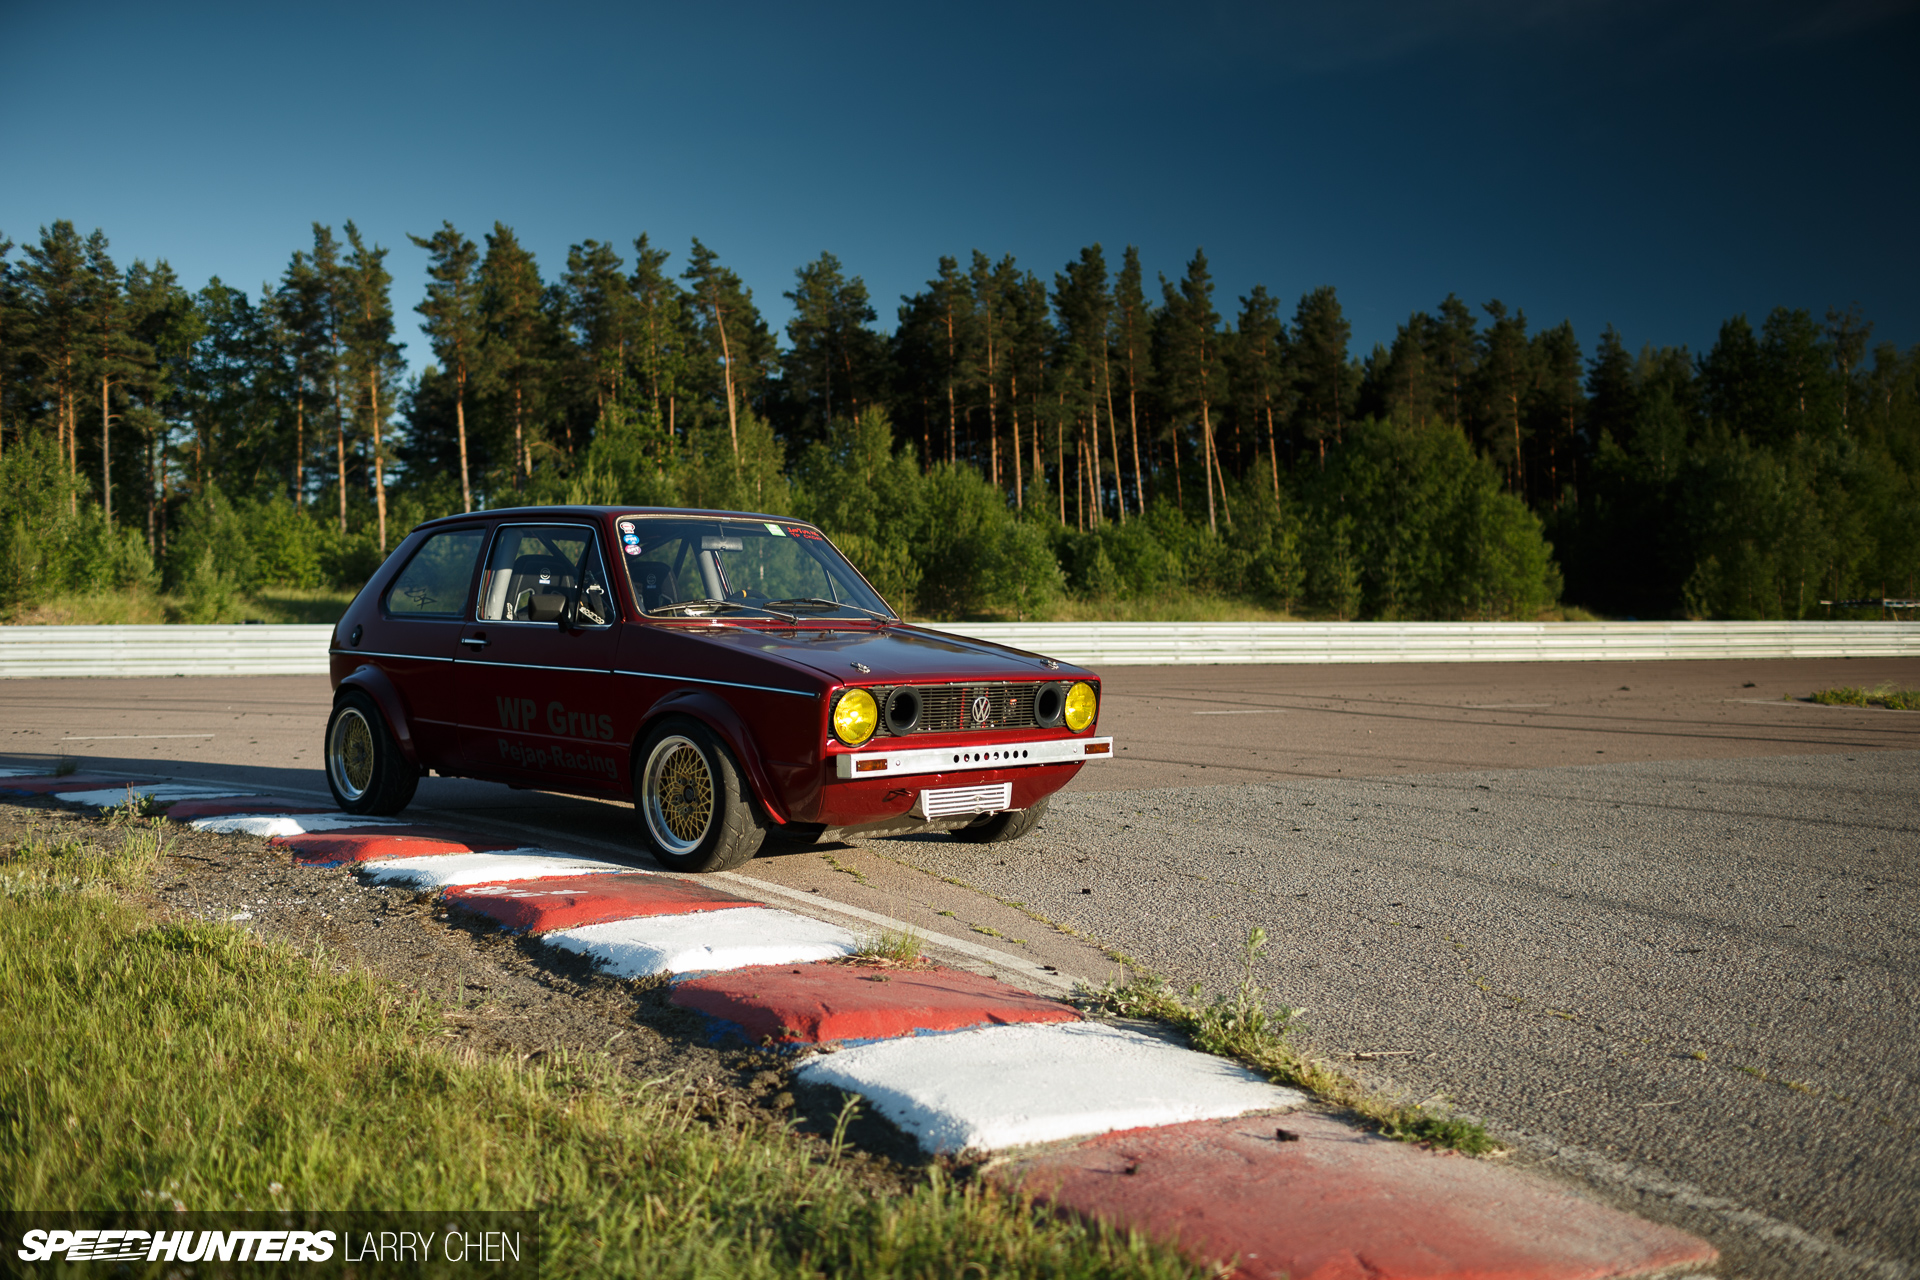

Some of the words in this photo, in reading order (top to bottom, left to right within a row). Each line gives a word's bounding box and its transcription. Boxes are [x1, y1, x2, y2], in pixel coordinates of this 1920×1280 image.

[496, 696, 537, 731] WP
[546, 701, 614, 740] Grus
[498, 738, 619, 779] Pejap-Racing
